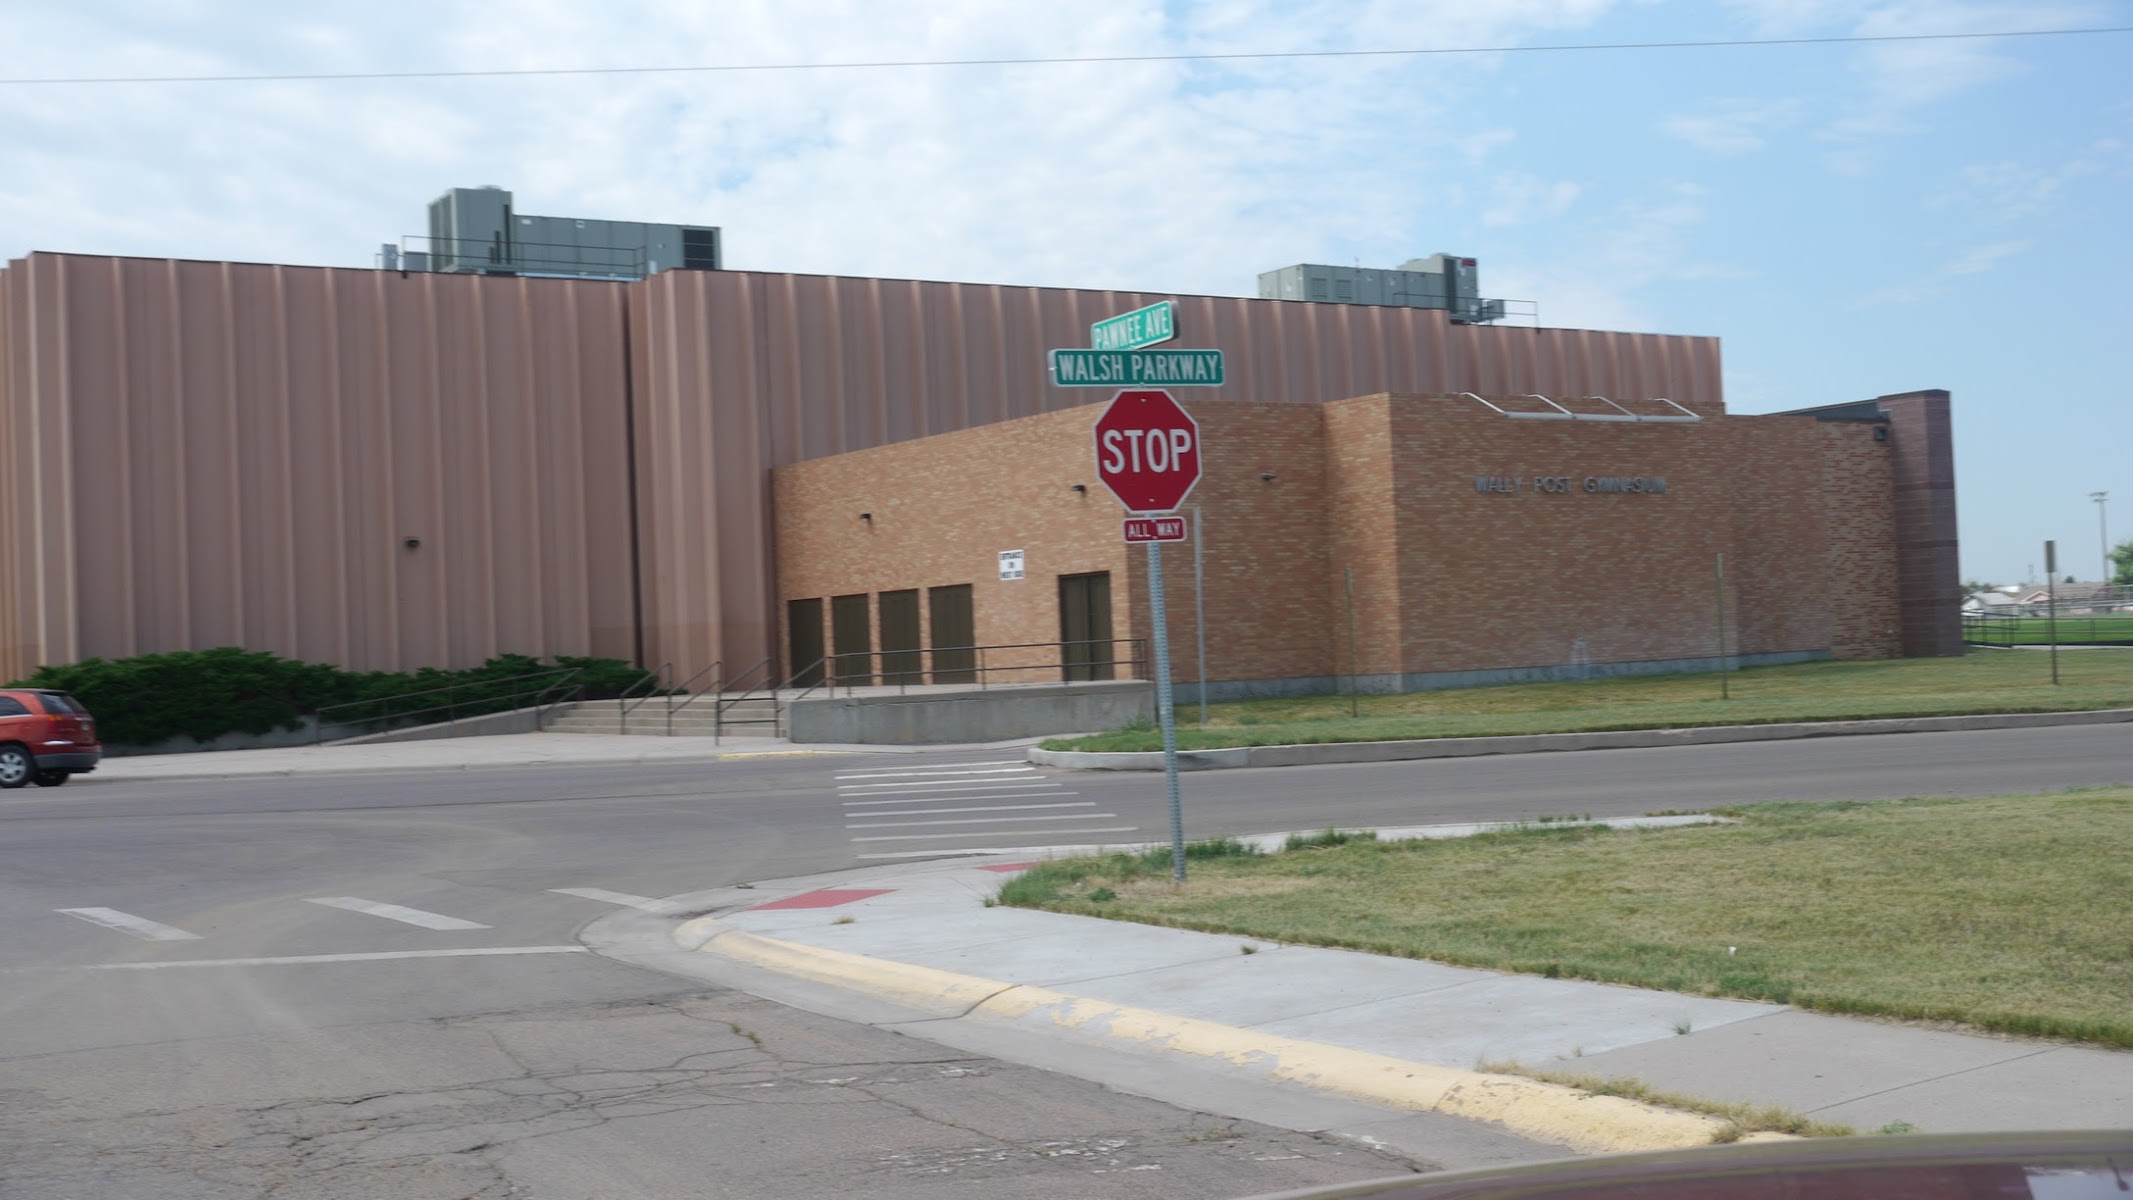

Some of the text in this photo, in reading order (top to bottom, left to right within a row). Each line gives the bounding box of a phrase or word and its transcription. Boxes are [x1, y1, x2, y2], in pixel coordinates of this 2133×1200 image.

[1094, 306, 1169, 349] PAWNEE AVE
[1058, 354, 1218, 381] WALSH PARKWAY
[1103, 428, 1192, 474] STOP
[1475, 476, 1523, 493] WALLY
[1533, 476, 1573, 493] POST
[1128, 522, 1180, 538] ALL WAY
